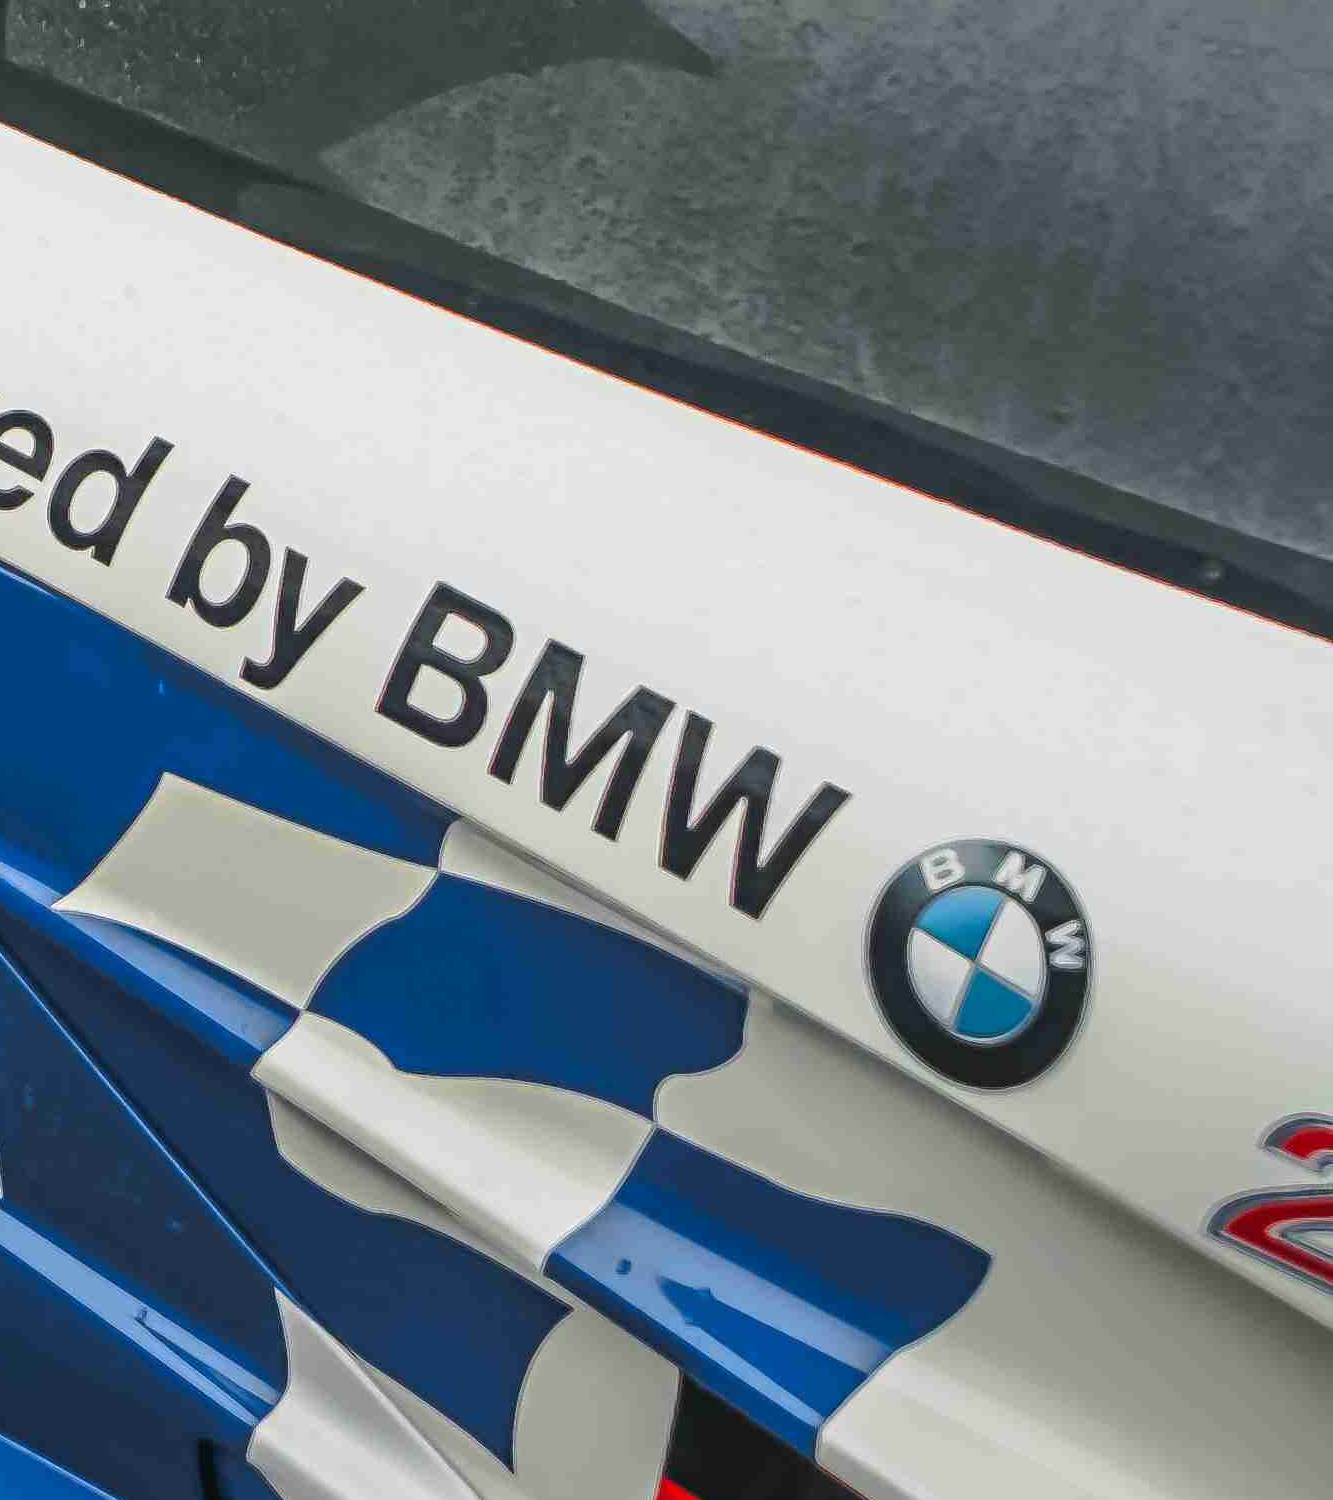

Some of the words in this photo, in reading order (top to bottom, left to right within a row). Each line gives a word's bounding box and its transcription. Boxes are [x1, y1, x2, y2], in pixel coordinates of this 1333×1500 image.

[167, 472, 364, 692] by
[376, 581, 853, 920] BMW
[918, 847, 1088, 971] BMW
